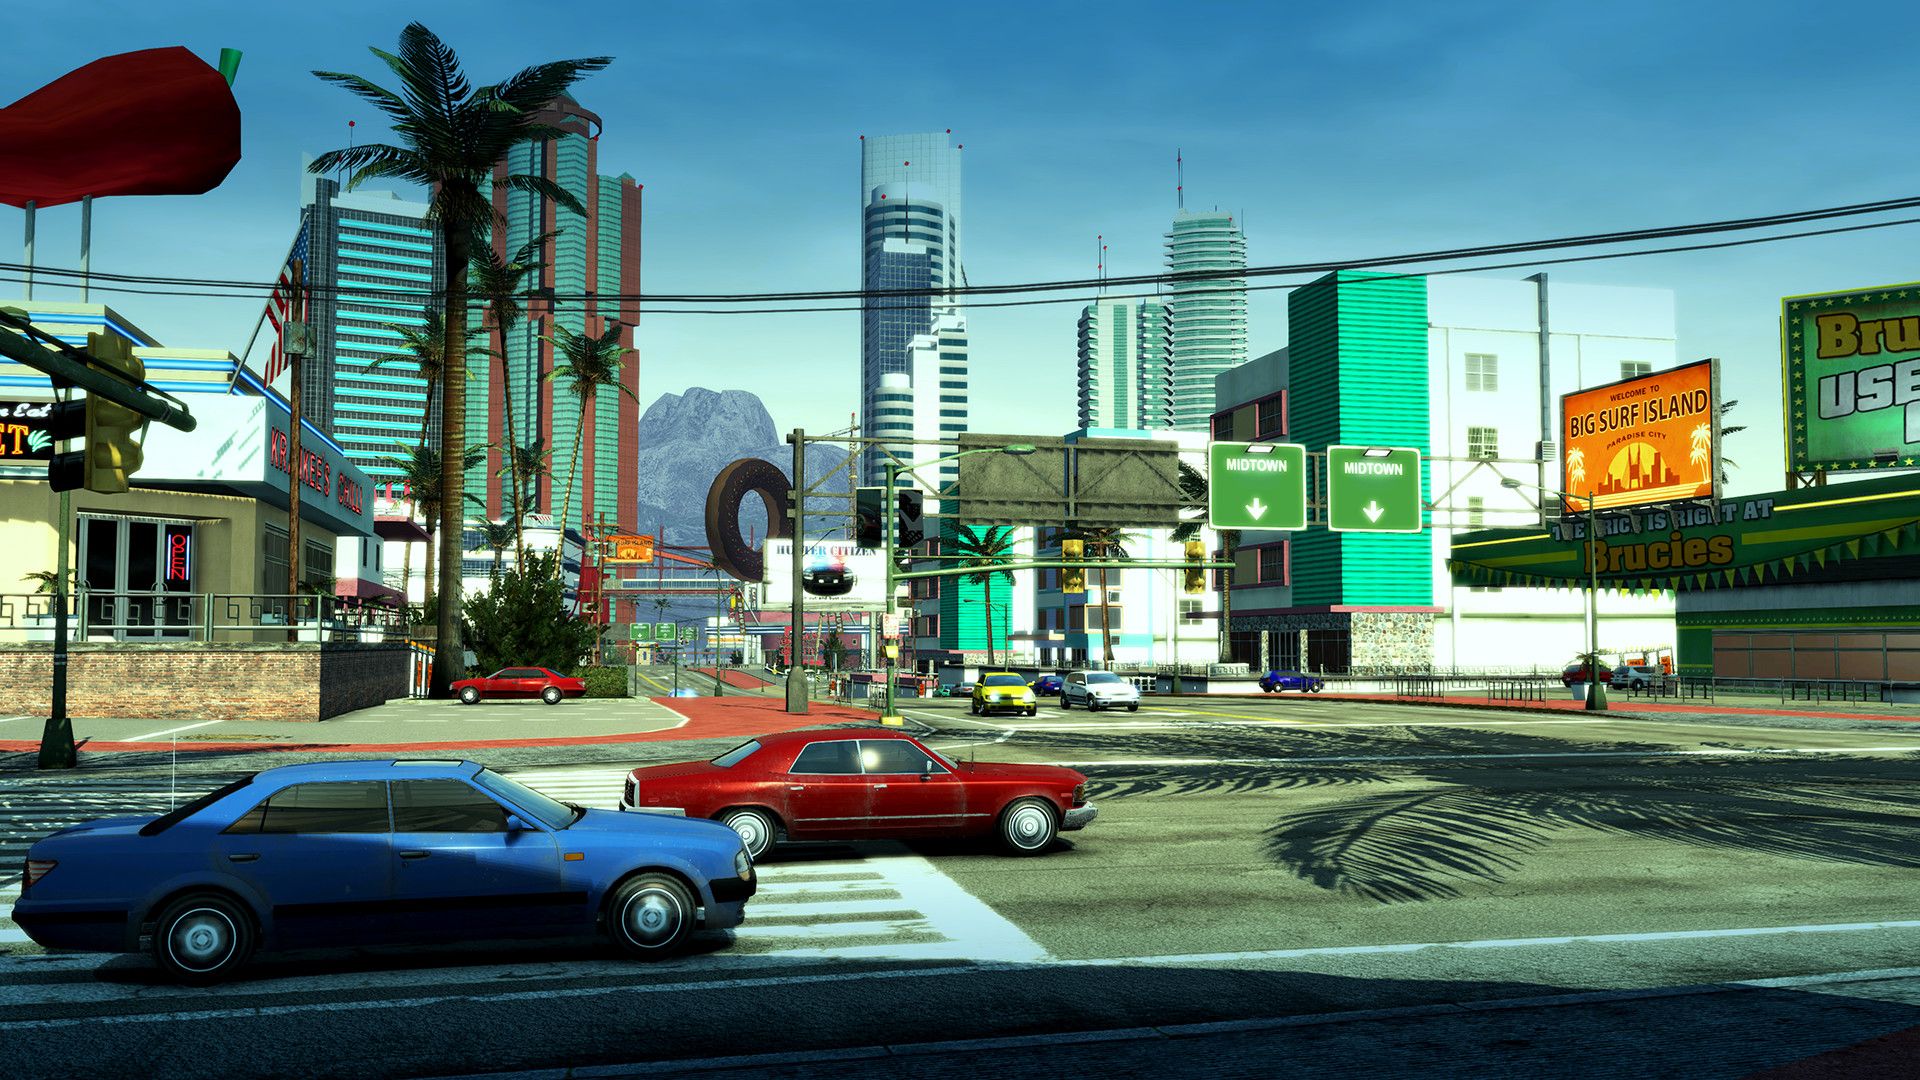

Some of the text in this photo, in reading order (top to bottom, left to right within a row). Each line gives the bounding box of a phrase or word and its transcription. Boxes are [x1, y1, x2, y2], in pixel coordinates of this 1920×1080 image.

[1817, 313, 1920, 359] Bru
[1610, 384, 1660, 402] WELCOME TO
[1818, 357, 1920, 420] USE
[13, 403, 52, 417] Eat
[1570, 389, 1708, 438] BIG SURF ISLAND
[1606, 431, 1667, 449] PARADISE CITY
[271, 426, 331, 497] KRKEE'S
[338, 472, 363, 515] CHILLI
[1226, 458, 1287, 472] MIDTOWN
[1344, 461, 1403, 475] MIDTOWN
[1552, 522, 1585, 541] TE
[1597, 517, 1640, 536] RIC
[1647, 512, 1667, 531] IS
[1743, 499, 1773, 520] AT
[171, 534, 186, 580] OPEN
[776, 545, 877, 556] HUTER CITIZEN
[1583, 531, 1734, 574] Brucies
